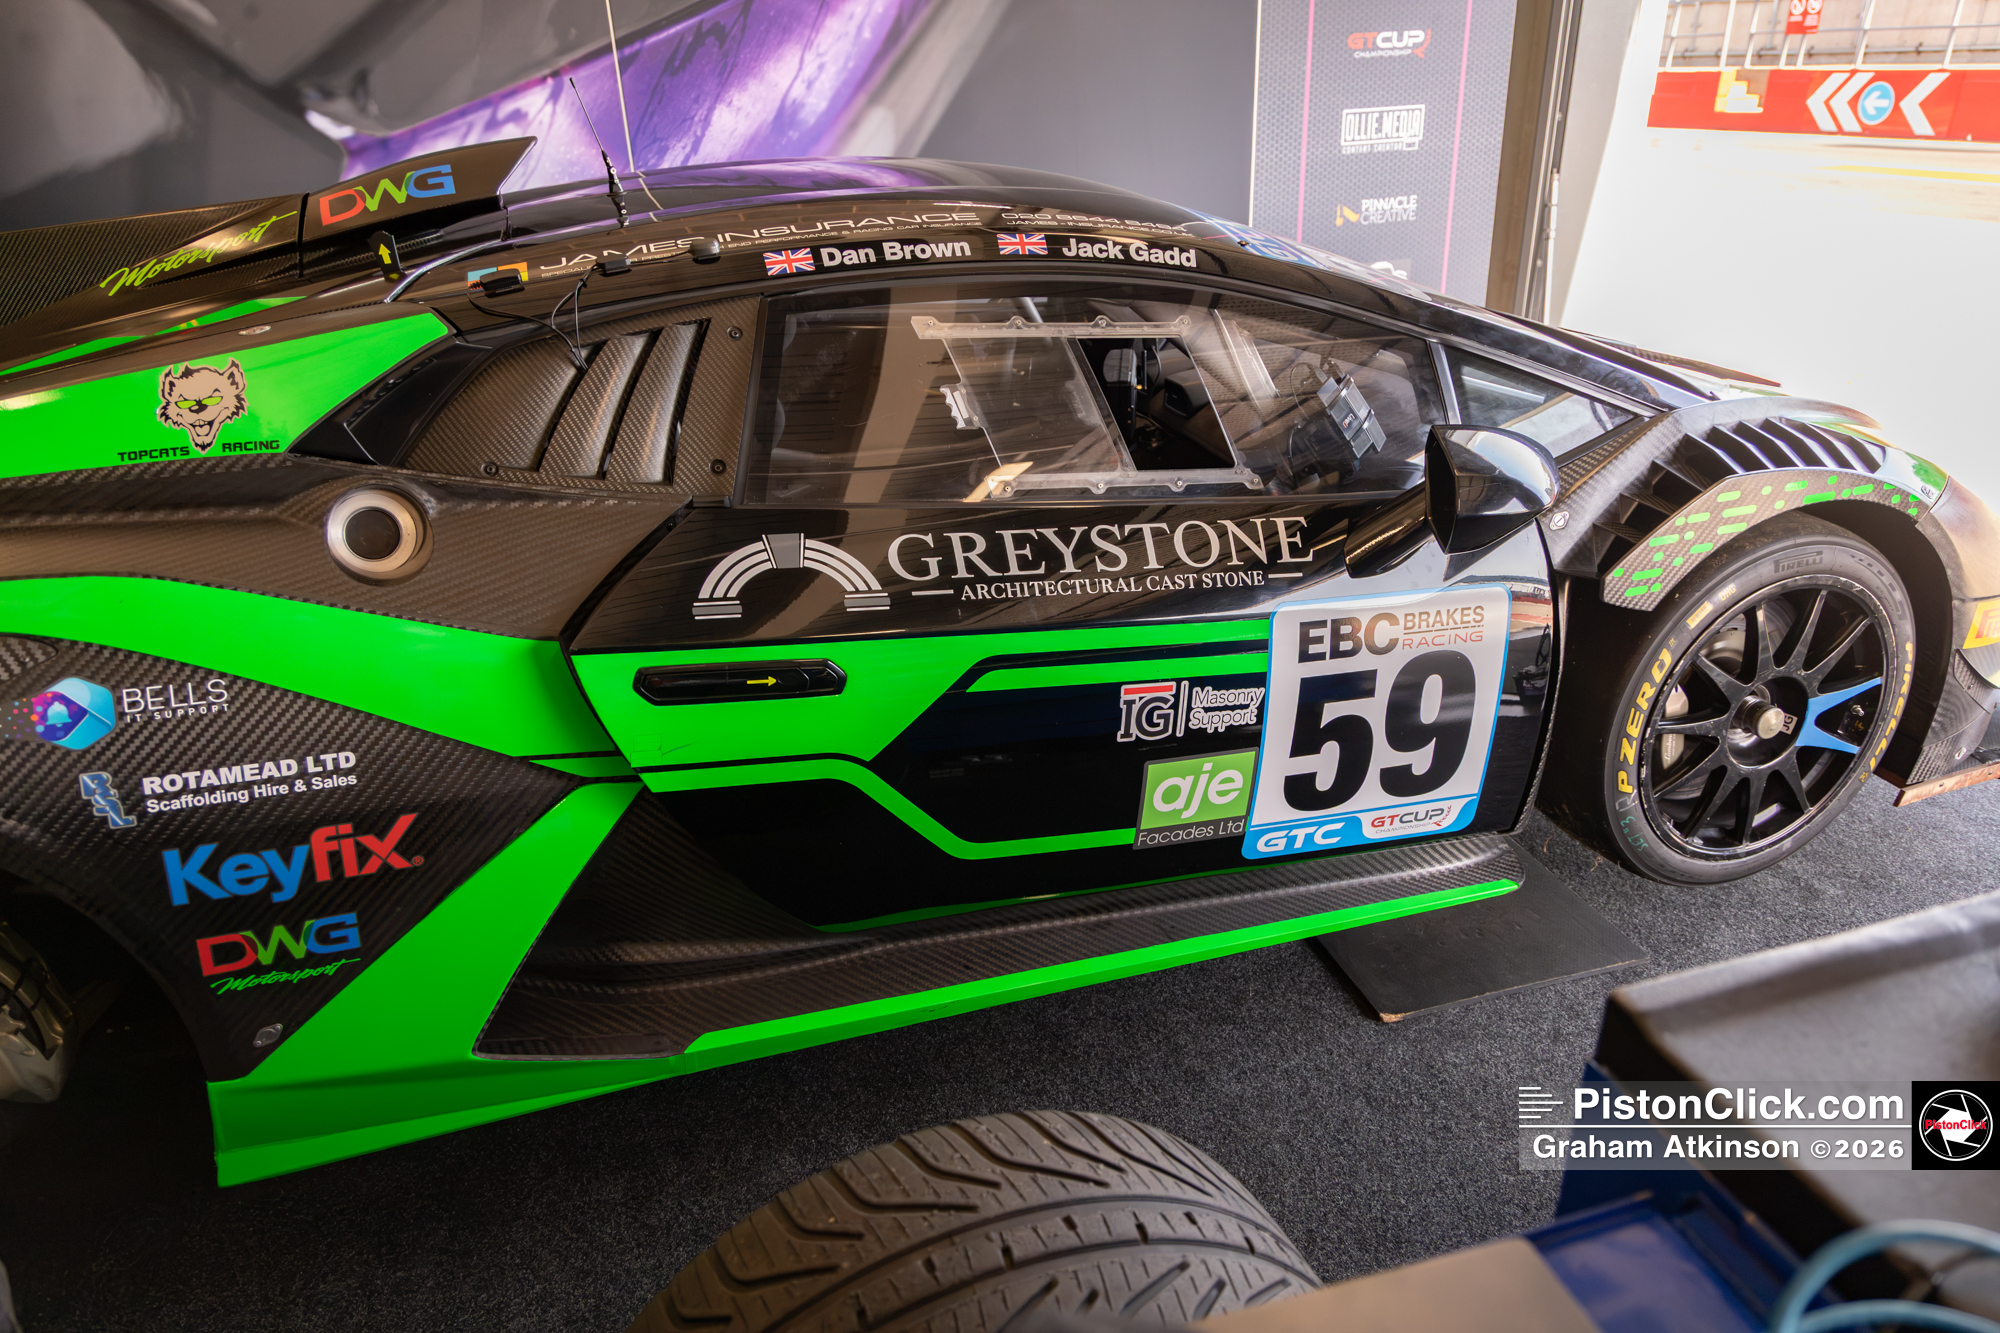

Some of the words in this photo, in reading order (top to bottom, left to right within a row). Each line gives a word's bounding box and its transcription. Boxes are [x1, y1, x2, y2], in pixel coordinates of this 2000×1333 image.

[319, 164, 456, 226] DWG
[1361, 195, 1418, 212] PINNACLE
[717, 212, 980, 243] INSURANCE
[1360, 208, 1417, 225] CREATIVE
[755, 229, 839, 245] PERFORMANCE
[853, 226, 894, 234] RACING
[922, 221, 983, 229] INSURANCE
[100, 211, 297, 296] Motorsport
[820, 246, 877, 267] Dan
[882, 241, 972, 261] Brown
[1062, 238, 1124, 260] Jack
[1129, 242, 1197, 268] Gadd
[117, 446, 190, 462] TOPCATS
[221, 440, 280, 453] RACING
[888, 516, 1315, 582] GREYSTONE
[1773, 550, 1823, 574] PIRELLI
[960, 575, 1145, 600] ARCHITECTURAL
[1146, 573, 1198, 593] CAST
[1201, 570, 1266, 590] STONE
[1298, 612, 1399, 664] EBC
[1403, 606, 1485, 630] BRAKES
[1402, 630, 1484, 651] RACING
[122, 679, 228, 713] BELLS
[1193, 686, 1265, 709] Masonry
[126, 714, 142, 723] IT
[154, 703, 230, 721] SUPPORT
[1118, 694, 1174, 741] IG
[1189, 709, 1257, 733] Support
[1283, 650, 1476, 812] 59
[143, 758, 299, 795] ROTAMEAD
[306, 751, 357, 774] LTD
[146, 789, 250, 814] Scaffolding
[253, 782, 289, 798] Hire
[294, 778, 307, 792] &
[311, 772, 357, 790] Sales
[1152, 762, 1244, 819] aje
[1138, 820, 1214, 847] Facades
[1218, 818, 1245, 837] Ltd
[1371, 807, 1445, 829] GTCUP
[1375, 821, 1433, 835] CHAMPIONSHIP
[1256, 821, 1346, 853] GTC
[196, 912, 361, 977] DWG
[210, 958, 361, 995] Motorsport
